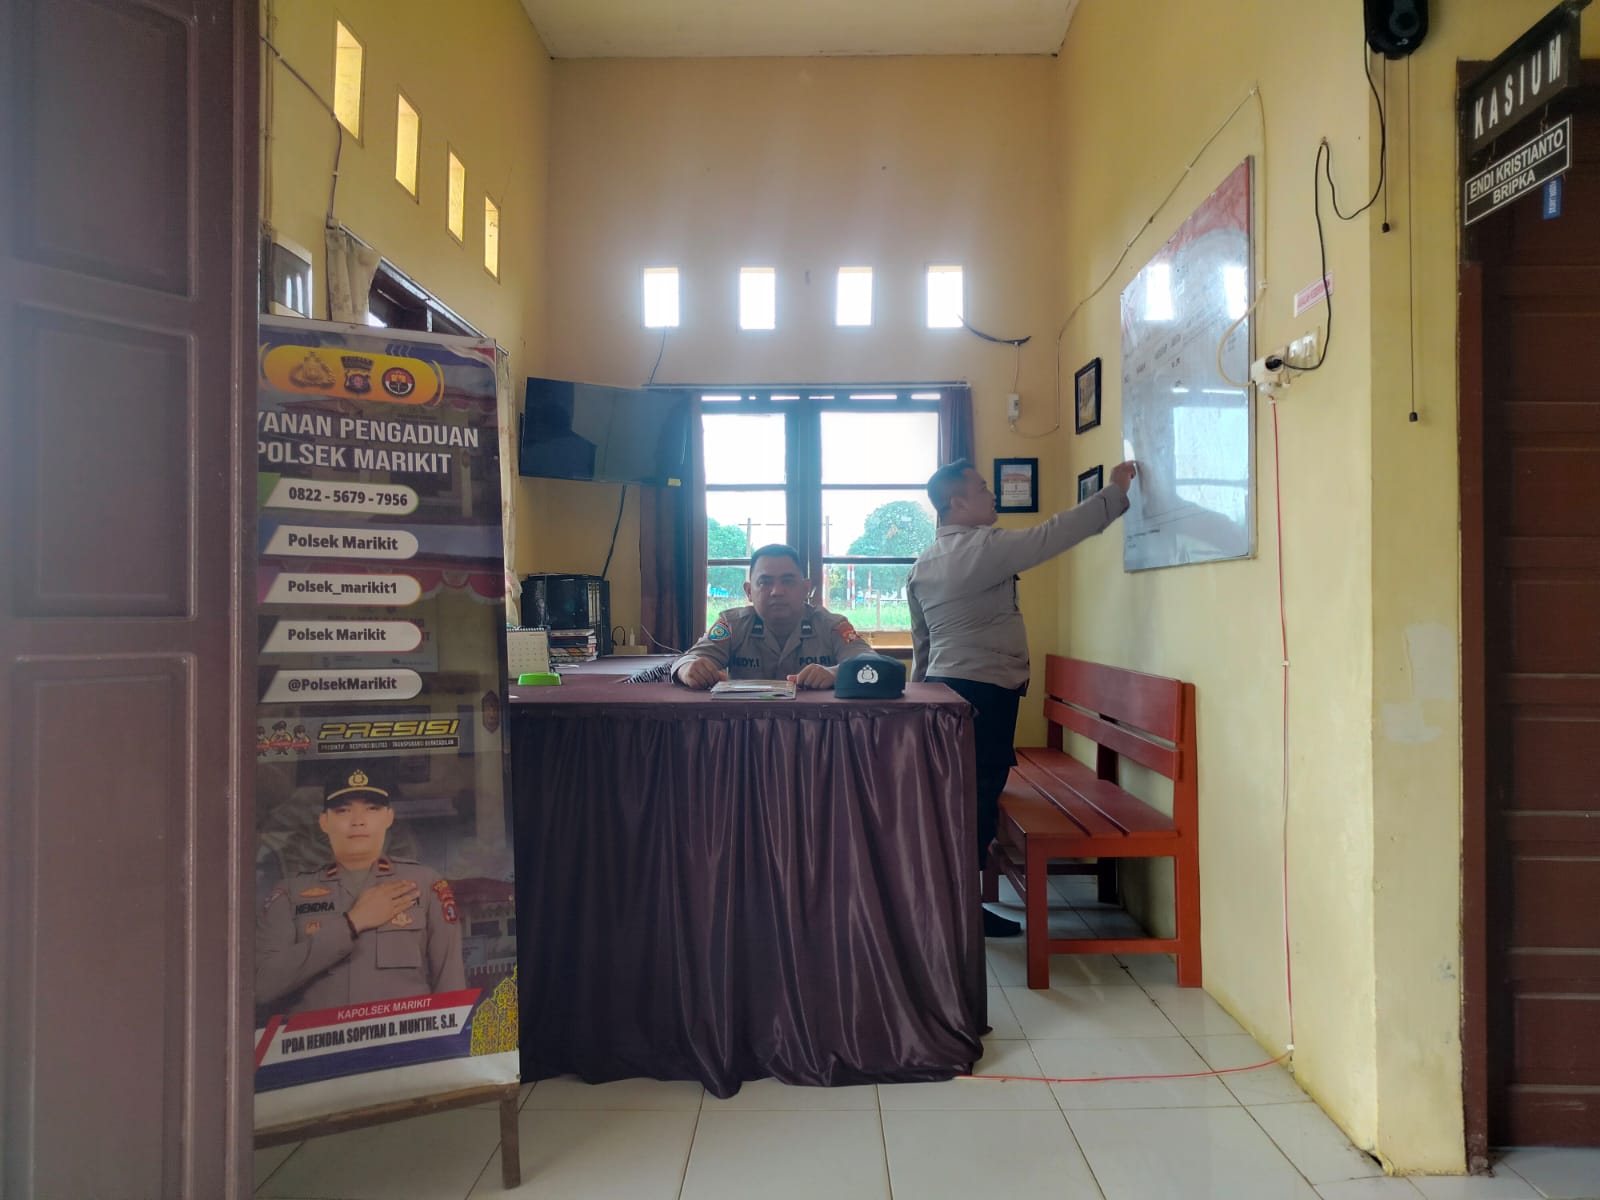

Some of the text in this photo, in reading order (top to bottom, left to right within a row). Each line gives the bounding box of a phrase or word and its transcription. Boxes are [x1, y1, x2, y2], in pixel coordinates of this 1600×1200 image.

[1474, 34, 1562, 139] KASIUM
[1469, 129, 1564, 200] ENDI KRISTIANTO
[1492, 169, 1536, 205] BRIPKA
[340, 418, 480, 448] PENGADUAN
[354, 449, 452, 474] MARIKIT
[288, 486, 322, 502] 0822
[333, 489, 366, 505] 5679
[376, 492, 408, 507] 7956
[288, 533, 398, 551] Polsek Marikit
[288, 580, 397, 596] Polsek_marikit1
[288, 628, 386, 641] Polsek Marikit
[288, 678, 397, 692] @PolsekMarikit
[318, 719, 460, 740] PRESISI
[295, 901, 335, 915] HENDRA
[337, 998, 432, 1021] KAPOLSEK MARIKIT
[281, 1013, 458, 1054] IPDA HENDRA SOPIYAN D. MUNTHE, S.H.
